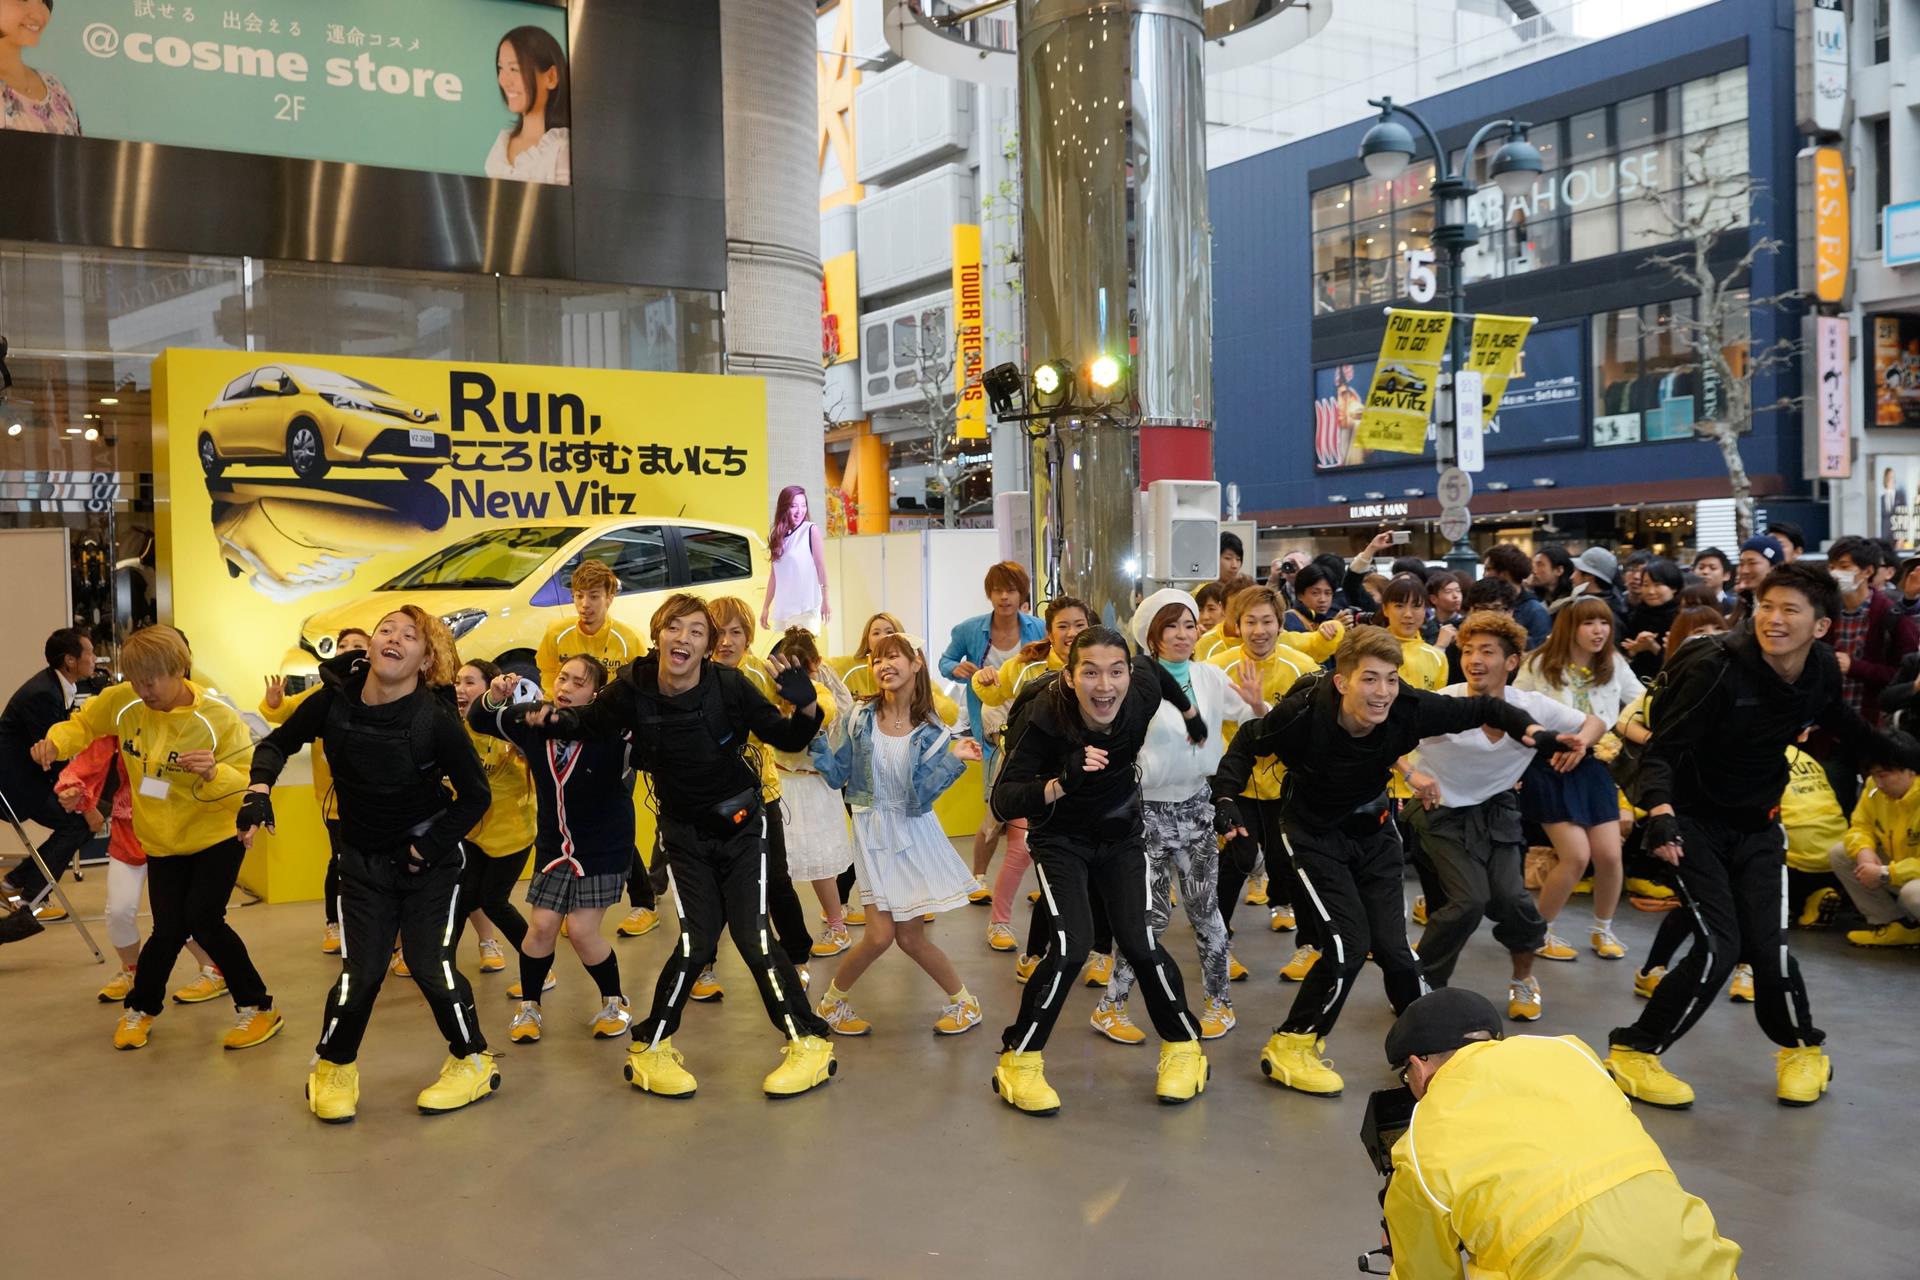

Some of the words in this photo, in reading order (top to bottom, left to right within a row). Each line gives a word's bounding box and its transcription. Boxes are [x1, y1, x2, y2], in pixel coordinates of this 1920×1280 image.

[223, 10, 302, 37] 出会える
[326, 23, 422, 51] 運命コスメ
[82, 21, 308, 82] @cosme
[325, 52, 463, 101] store
[273, 93, 305, 121] 2F
[961, 262, 981, 320] TOWER
[1405, 250, 1437, 303] 5
[1389, 315, 1411, 332] FUN
[1414, 317, 1446, 334] PLACE
[1395, 336, 1408, 350] TO
[1396, 393, 1426, 411] Vitz
[450, 479, 550, 519] New
[555, 480, 638, 516] Vitz
[1350, 504, 1383, 518] LUMINE
[1384, 502, 1409, 517] MAN
